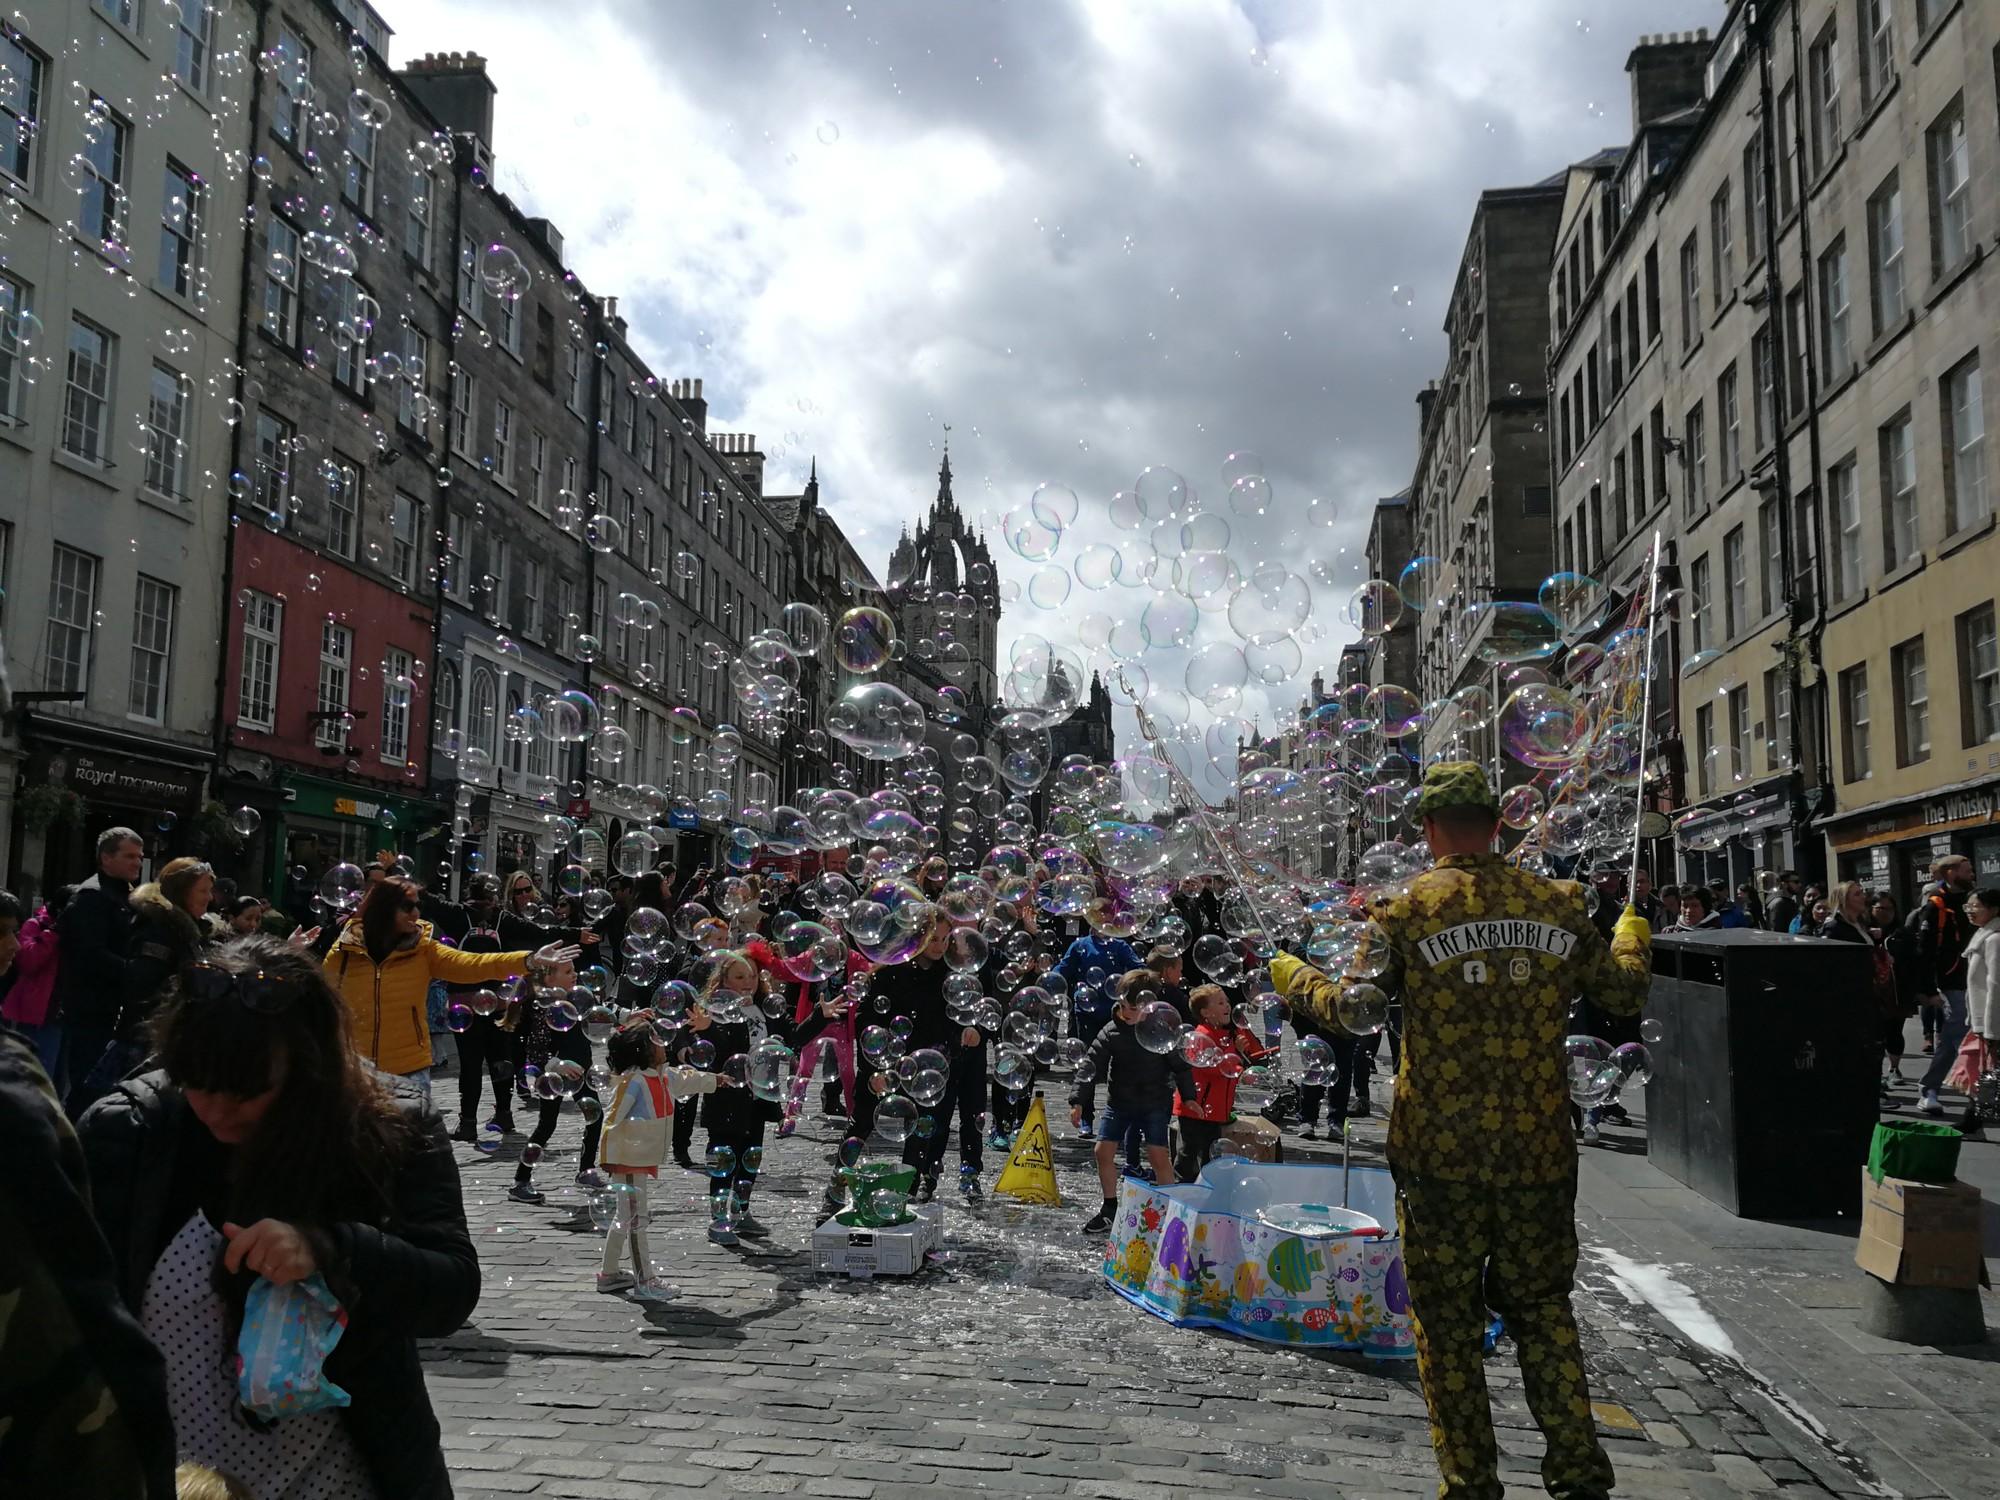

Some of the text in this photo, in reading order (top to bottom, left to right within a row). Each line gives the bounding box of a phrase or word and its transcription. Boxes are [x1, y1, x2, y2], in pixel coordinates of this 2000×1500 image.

[335, 798, 381, 819] SUBWAY
[1945, 791, 1992, 822] Whisky
[1426, 921, 1571, 962] FREAKBUBBLES
